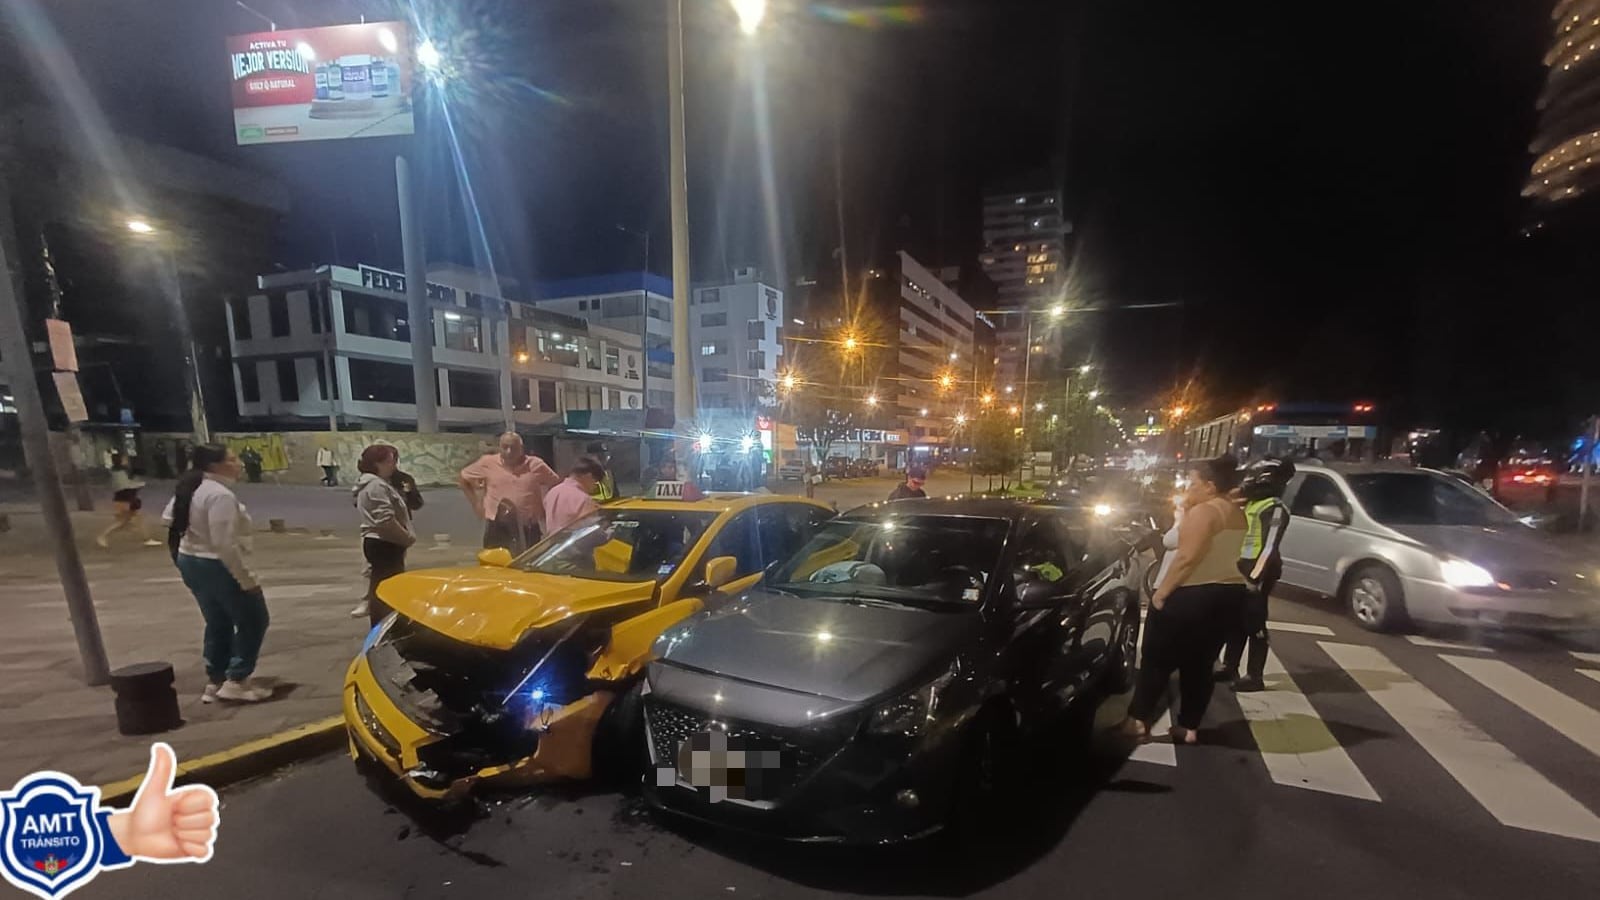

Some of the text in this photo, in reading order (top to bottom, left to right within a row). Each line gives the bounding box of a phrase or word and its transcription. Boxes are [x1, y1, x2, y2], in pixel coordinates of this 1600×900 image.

[249, 40, 287, 50] ACTIVA TU
[231, 52, 265, 80] MEJOR
[656, 483, 683, 496] TAXI
